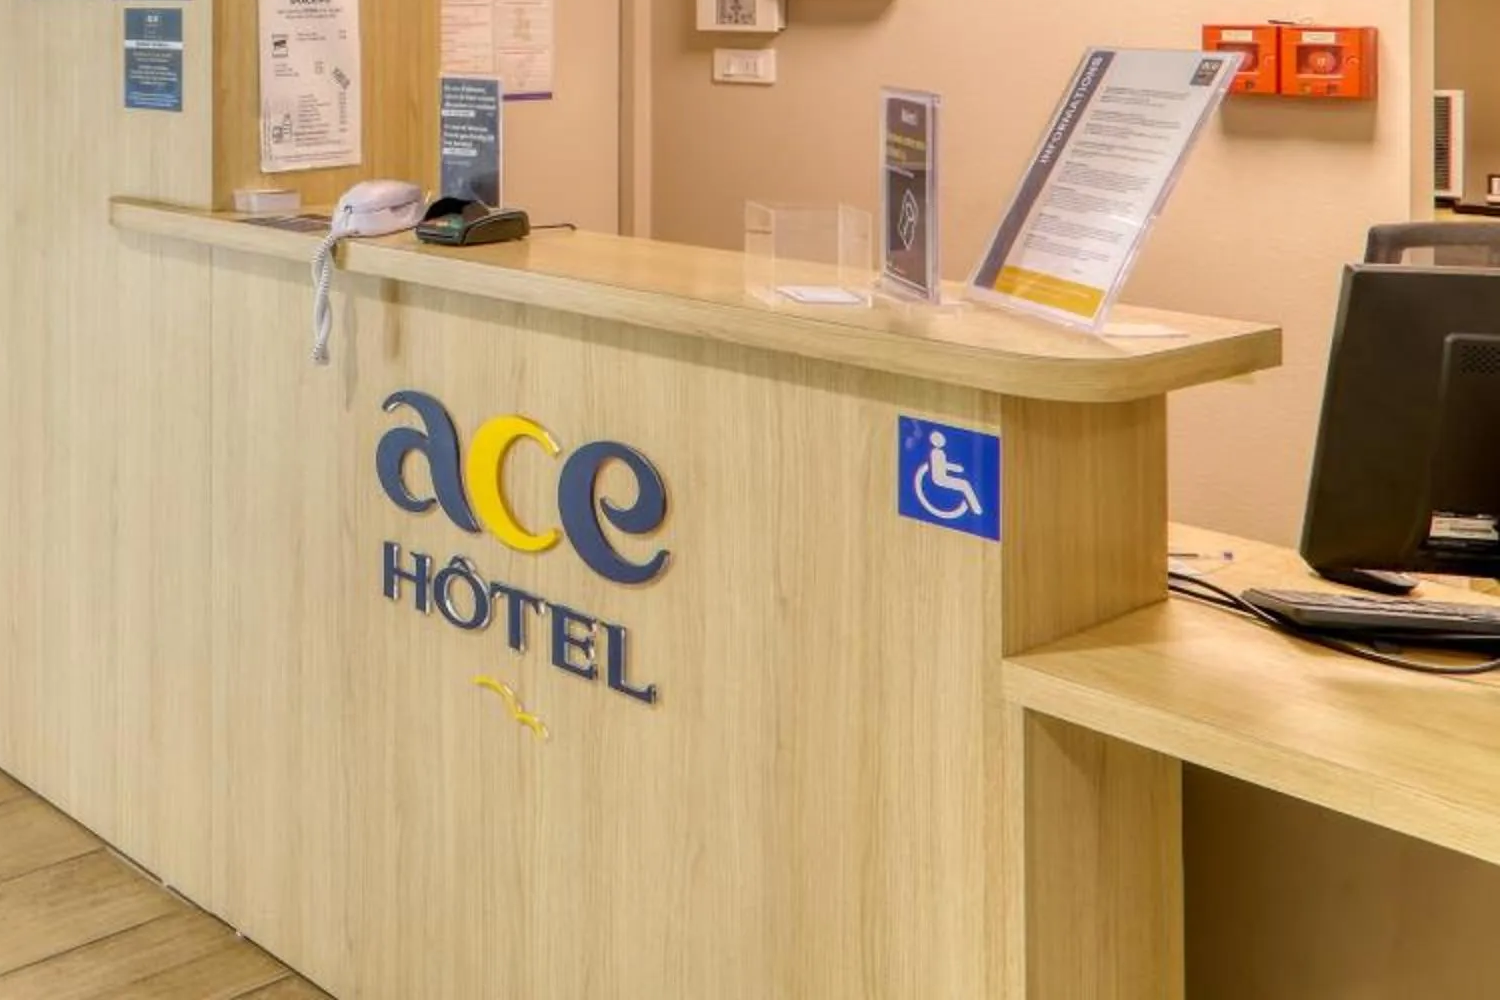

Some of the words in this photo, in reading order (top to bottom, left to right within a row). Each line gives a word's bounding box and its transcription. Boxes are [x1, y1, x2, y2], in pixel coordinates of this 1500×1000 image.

[1040, 56, 1104, 164] INFORMATIONS
[376, 390, 670, 584] ace
[383, 540, 657, 705] HÔTEL
